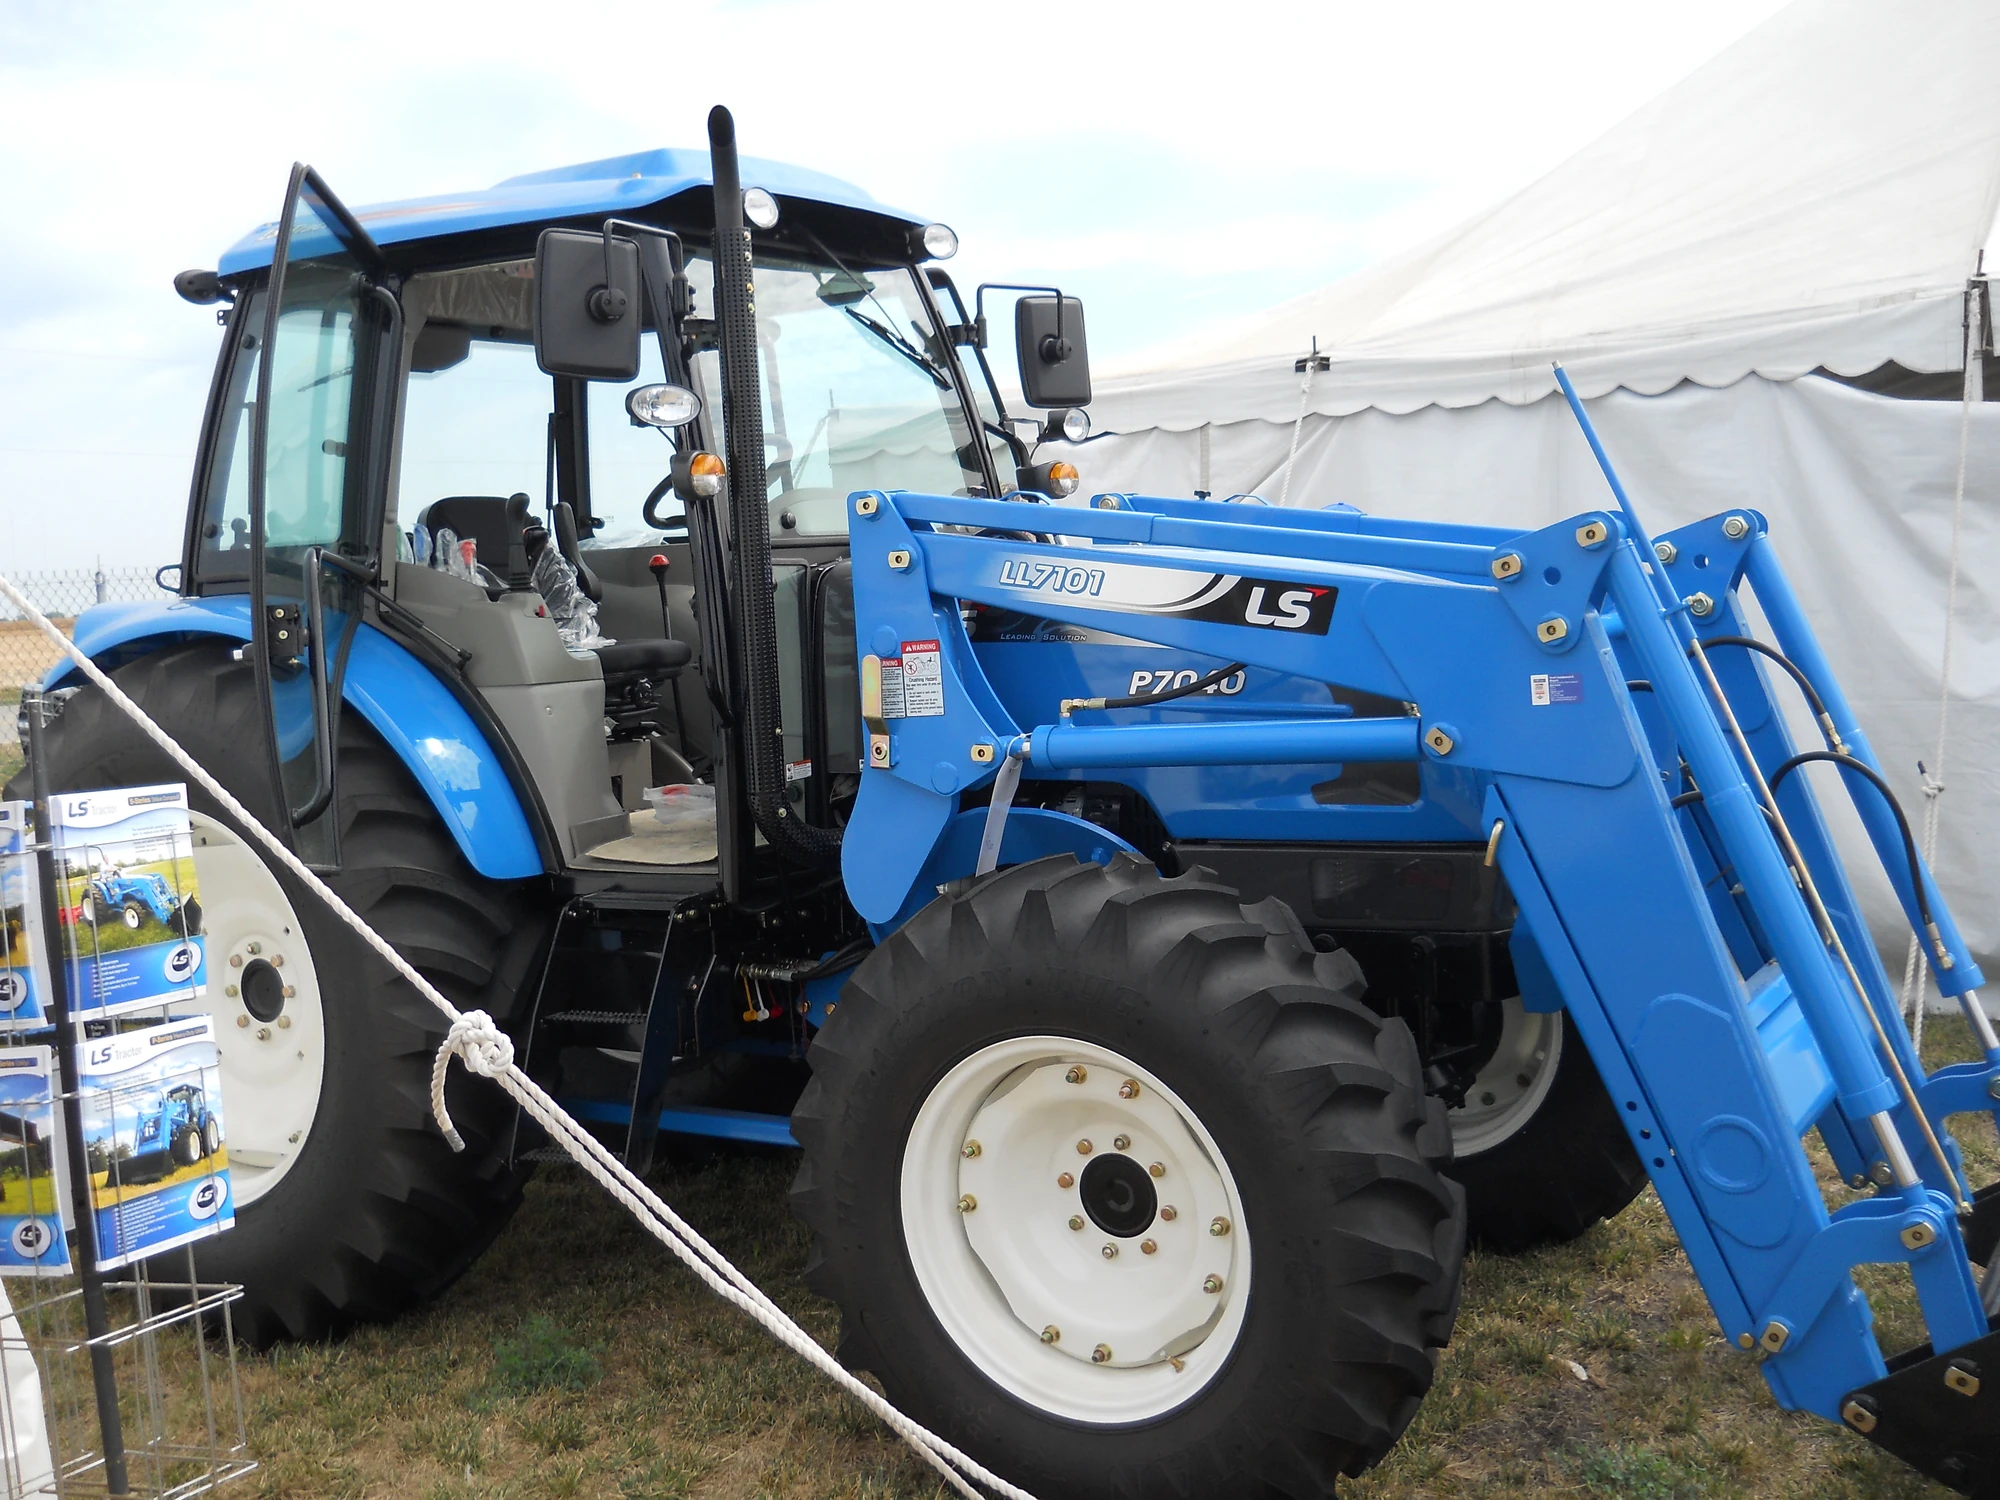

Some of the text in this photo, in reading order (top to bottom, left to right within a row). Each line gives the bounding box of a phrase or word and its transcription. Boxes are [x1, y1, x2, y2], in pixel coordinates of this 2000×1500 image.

[999, 560, 1106, 597] LL7101
[1245, 587, 1313, 628] LS
[1000, 633, 1088, 641] LEADING SOLUTION
[911, 643, 936, 651] WARNING
[68, 801, 118, 818] LS Tractor
[173, 955, 188, 966] LS
[91, 1046, 142, 1066] LS Tractor
[198, 1190, 214, 1202] LS
